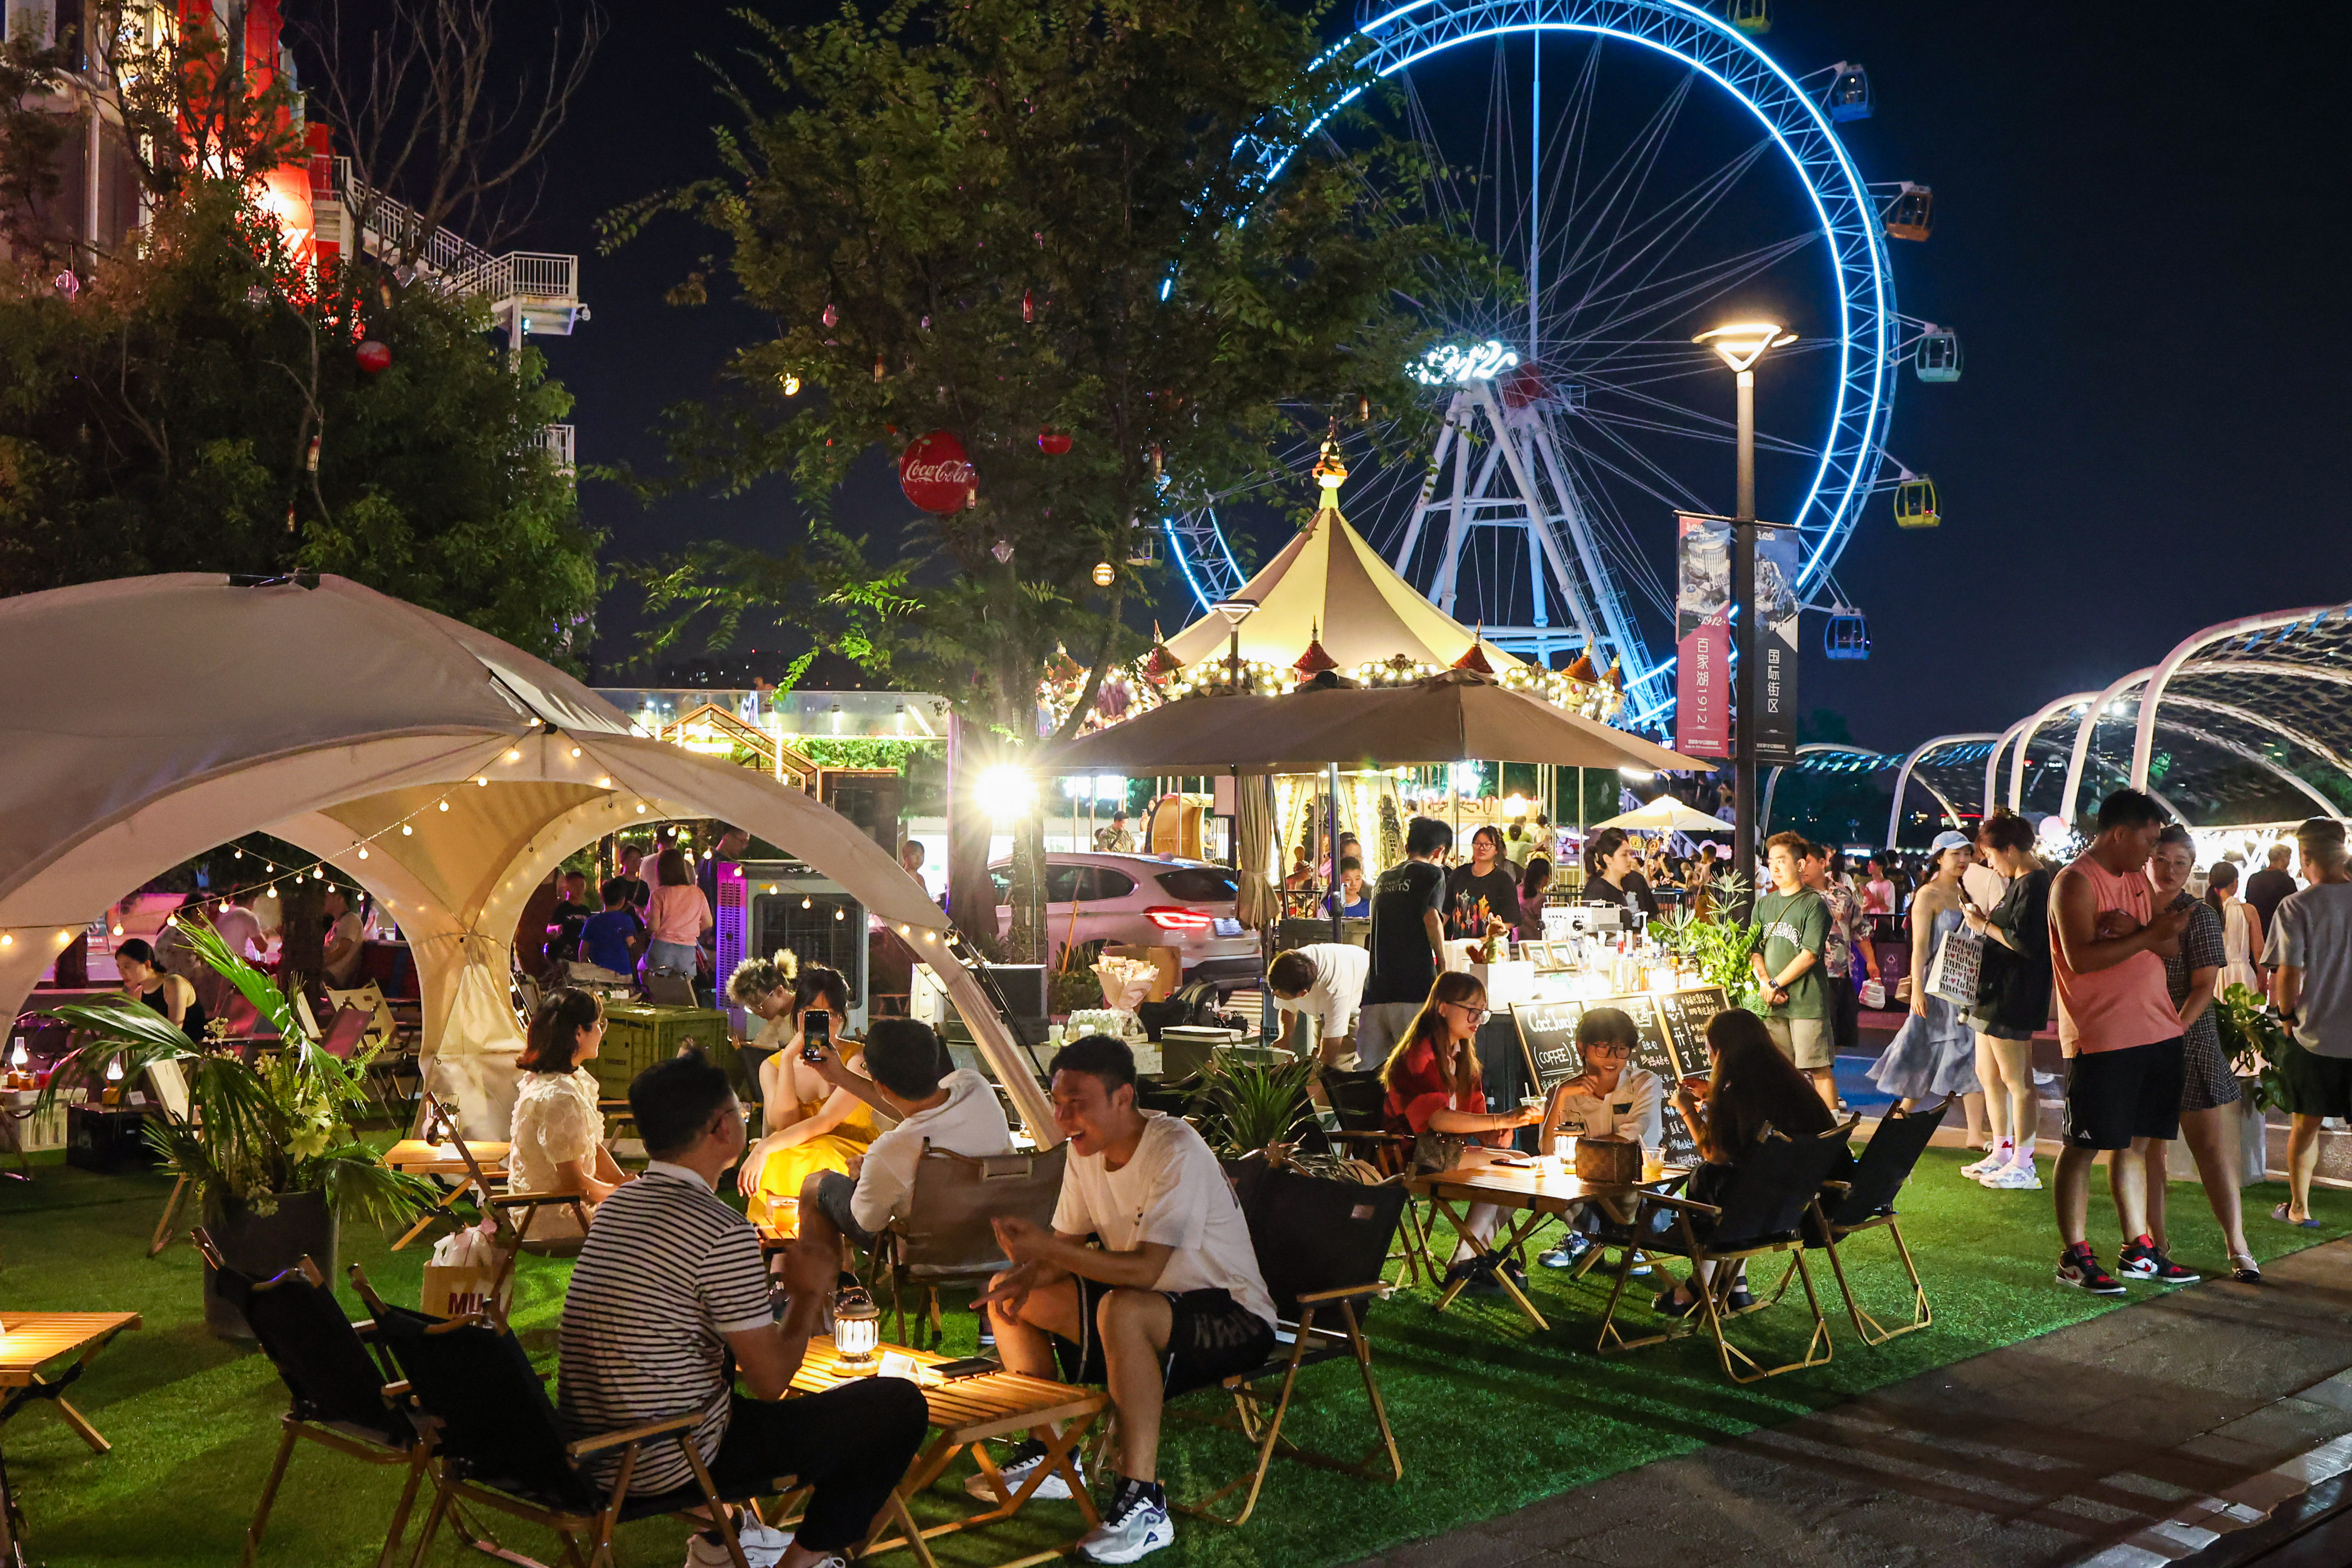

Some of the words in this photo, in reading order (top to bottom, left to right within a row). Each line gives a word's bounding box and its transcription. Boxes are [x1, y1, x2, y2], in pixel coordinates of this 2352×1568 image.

[1698, 616, 1726, 627] 1912
[1769, 621, 1792, 632] IPARK
[1697, 637, 1709, 723] 百家湖1912
[1768, 649, 1780, 713] 国际街区
[1534, 1042, 1572, 1069] (COFFEE)
[1663, 997, 1692, 1069] 想开了
